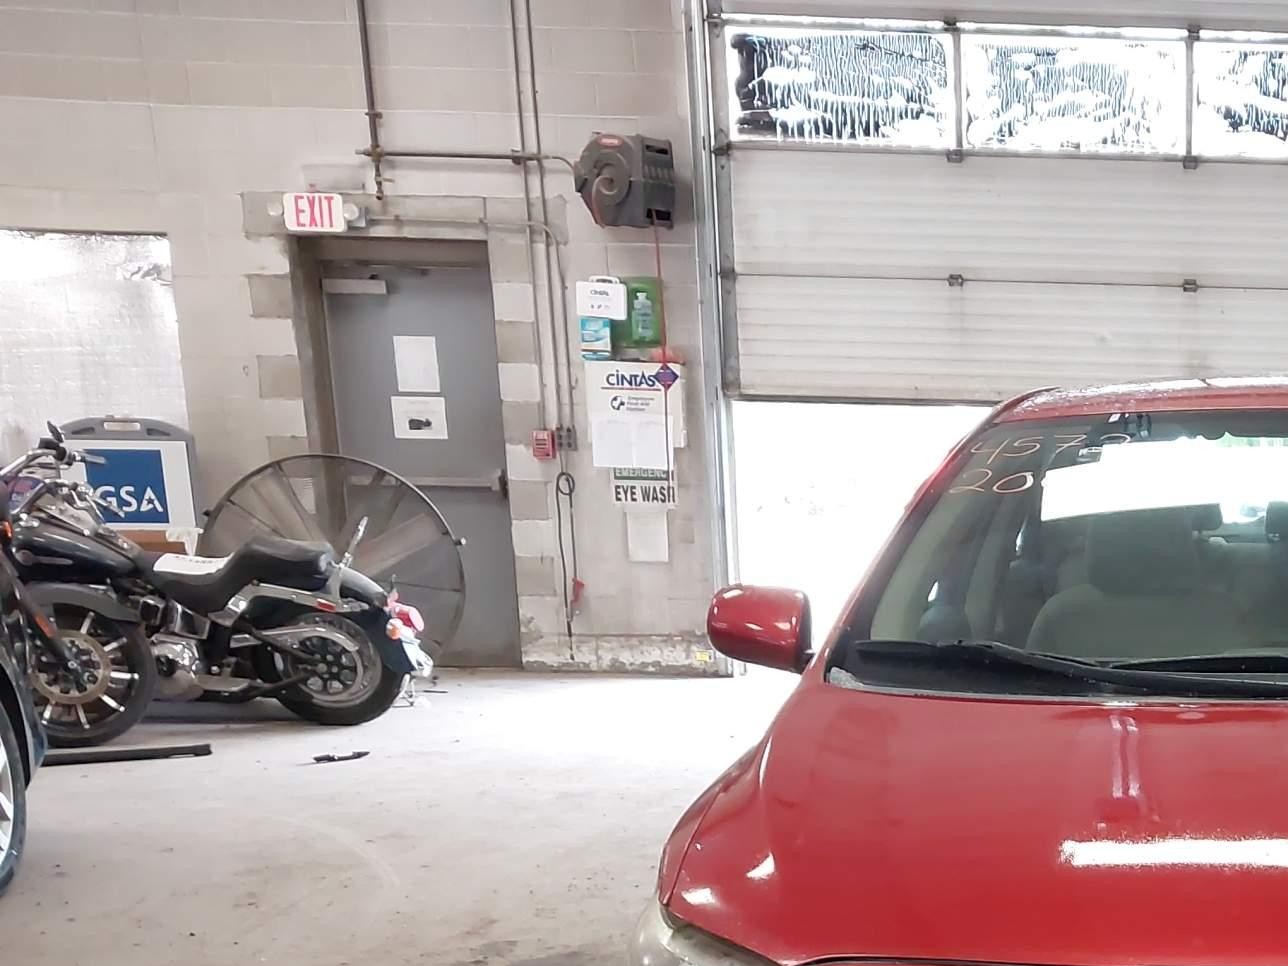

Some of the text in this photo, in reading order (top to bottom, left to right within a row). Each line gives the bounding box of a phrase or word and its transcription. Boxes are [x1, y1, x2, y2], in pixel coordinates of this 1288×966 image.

[295, 196, 334, 227] EXIT
[606, 369, 656, 387] CINTAS
[94, 485, 164, 513] GSA
[615, 485, 638, 502] EYE
